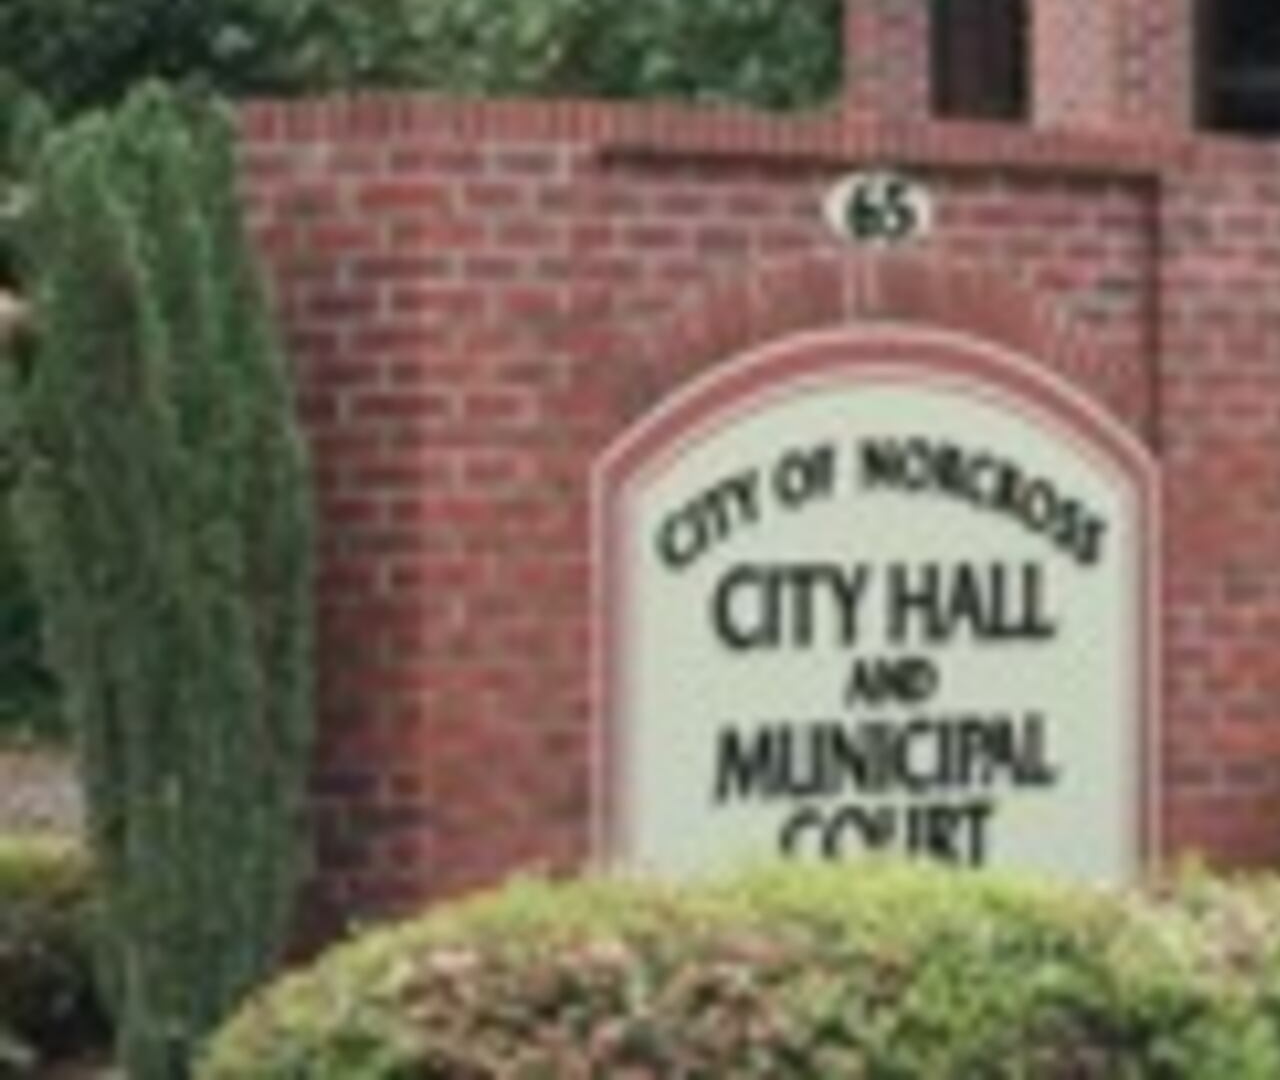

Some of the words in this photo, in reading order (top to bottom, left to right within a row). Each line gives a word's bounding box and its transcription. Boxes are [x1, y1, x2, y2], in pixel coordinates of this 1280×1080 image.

[846, 178, 917, 239] 65
[656, 470, 761, 571] CITY
[774, 446, 836, 508] OF
[859, 438, 1105, 565] NORCROSS
[711, 563, 867, 650] CITY
[886, 563, 1055, 646] HALL
[846, 658, 940, 708] AND
[712, 713, 1057, 804] MUNICIPAL
